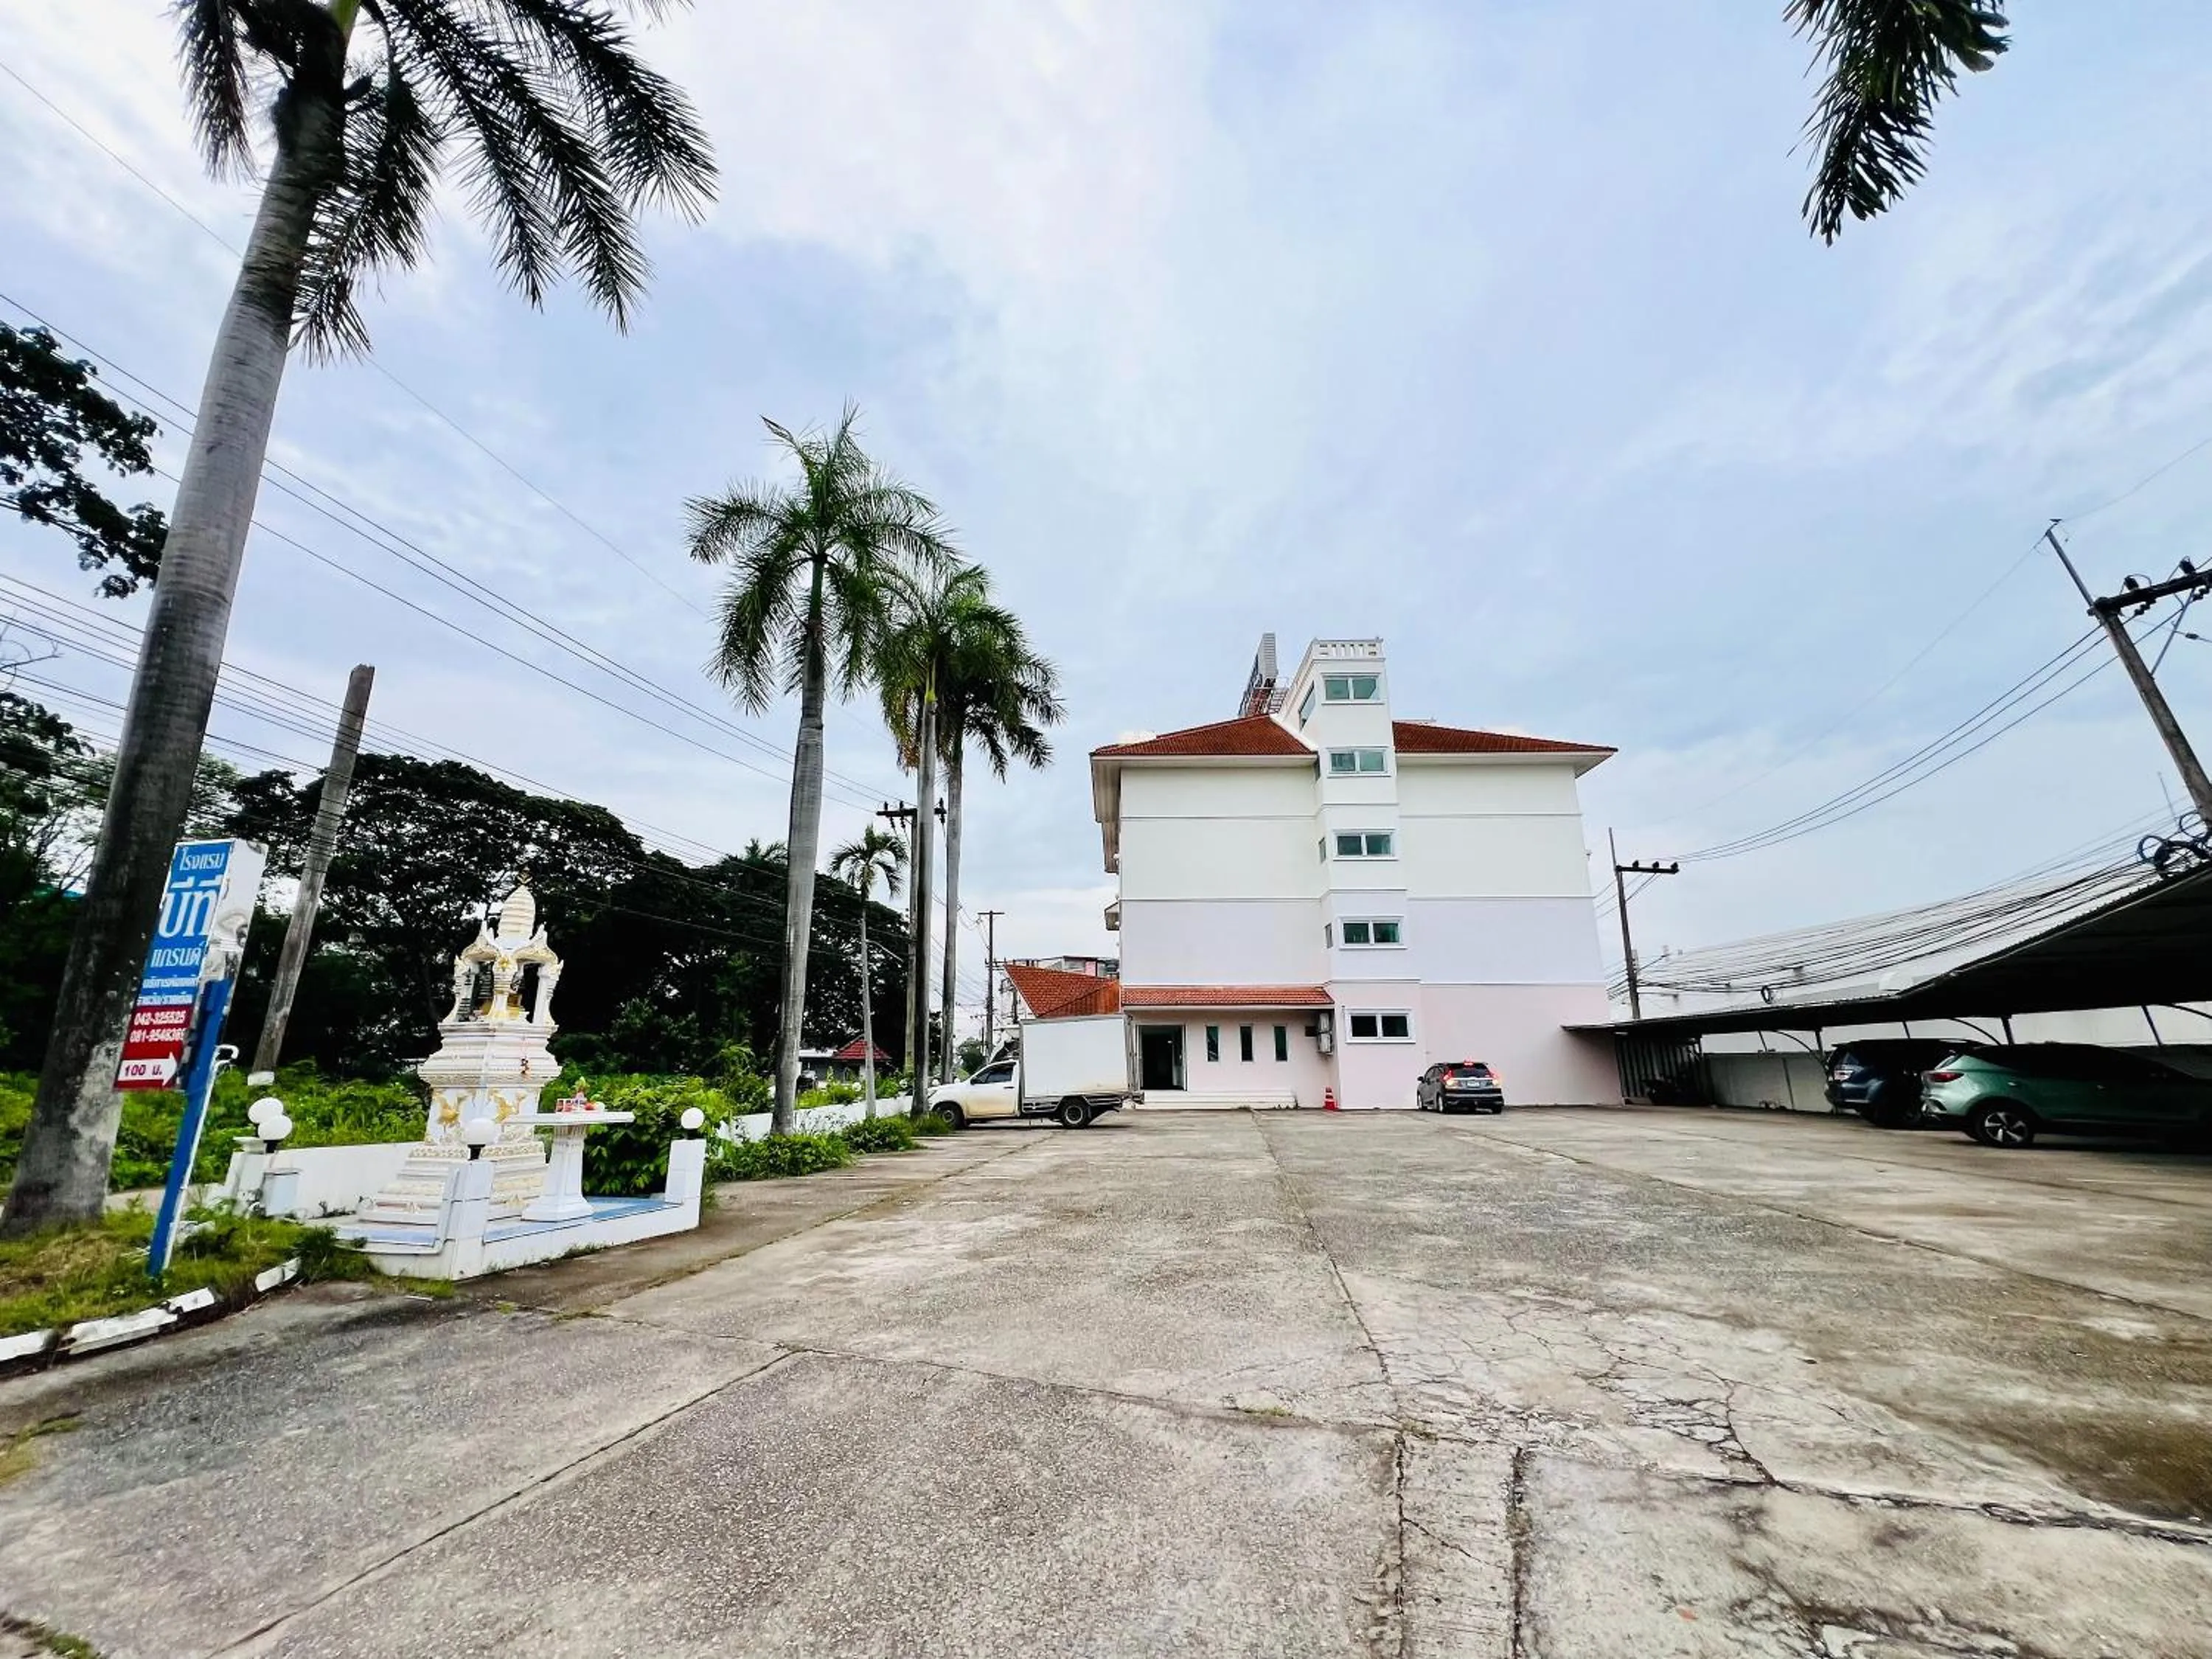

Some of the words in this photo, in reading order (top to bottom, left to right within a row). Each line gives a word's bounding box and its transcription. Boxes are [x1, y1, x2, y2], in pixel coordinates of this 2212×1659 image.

[179, 846, 226, 871] โรงแรม
[158, 874, 224, 939] บีที
[150, 940, 205, 967] แกรนด์
[125, 1064, 146, 1077] 100
